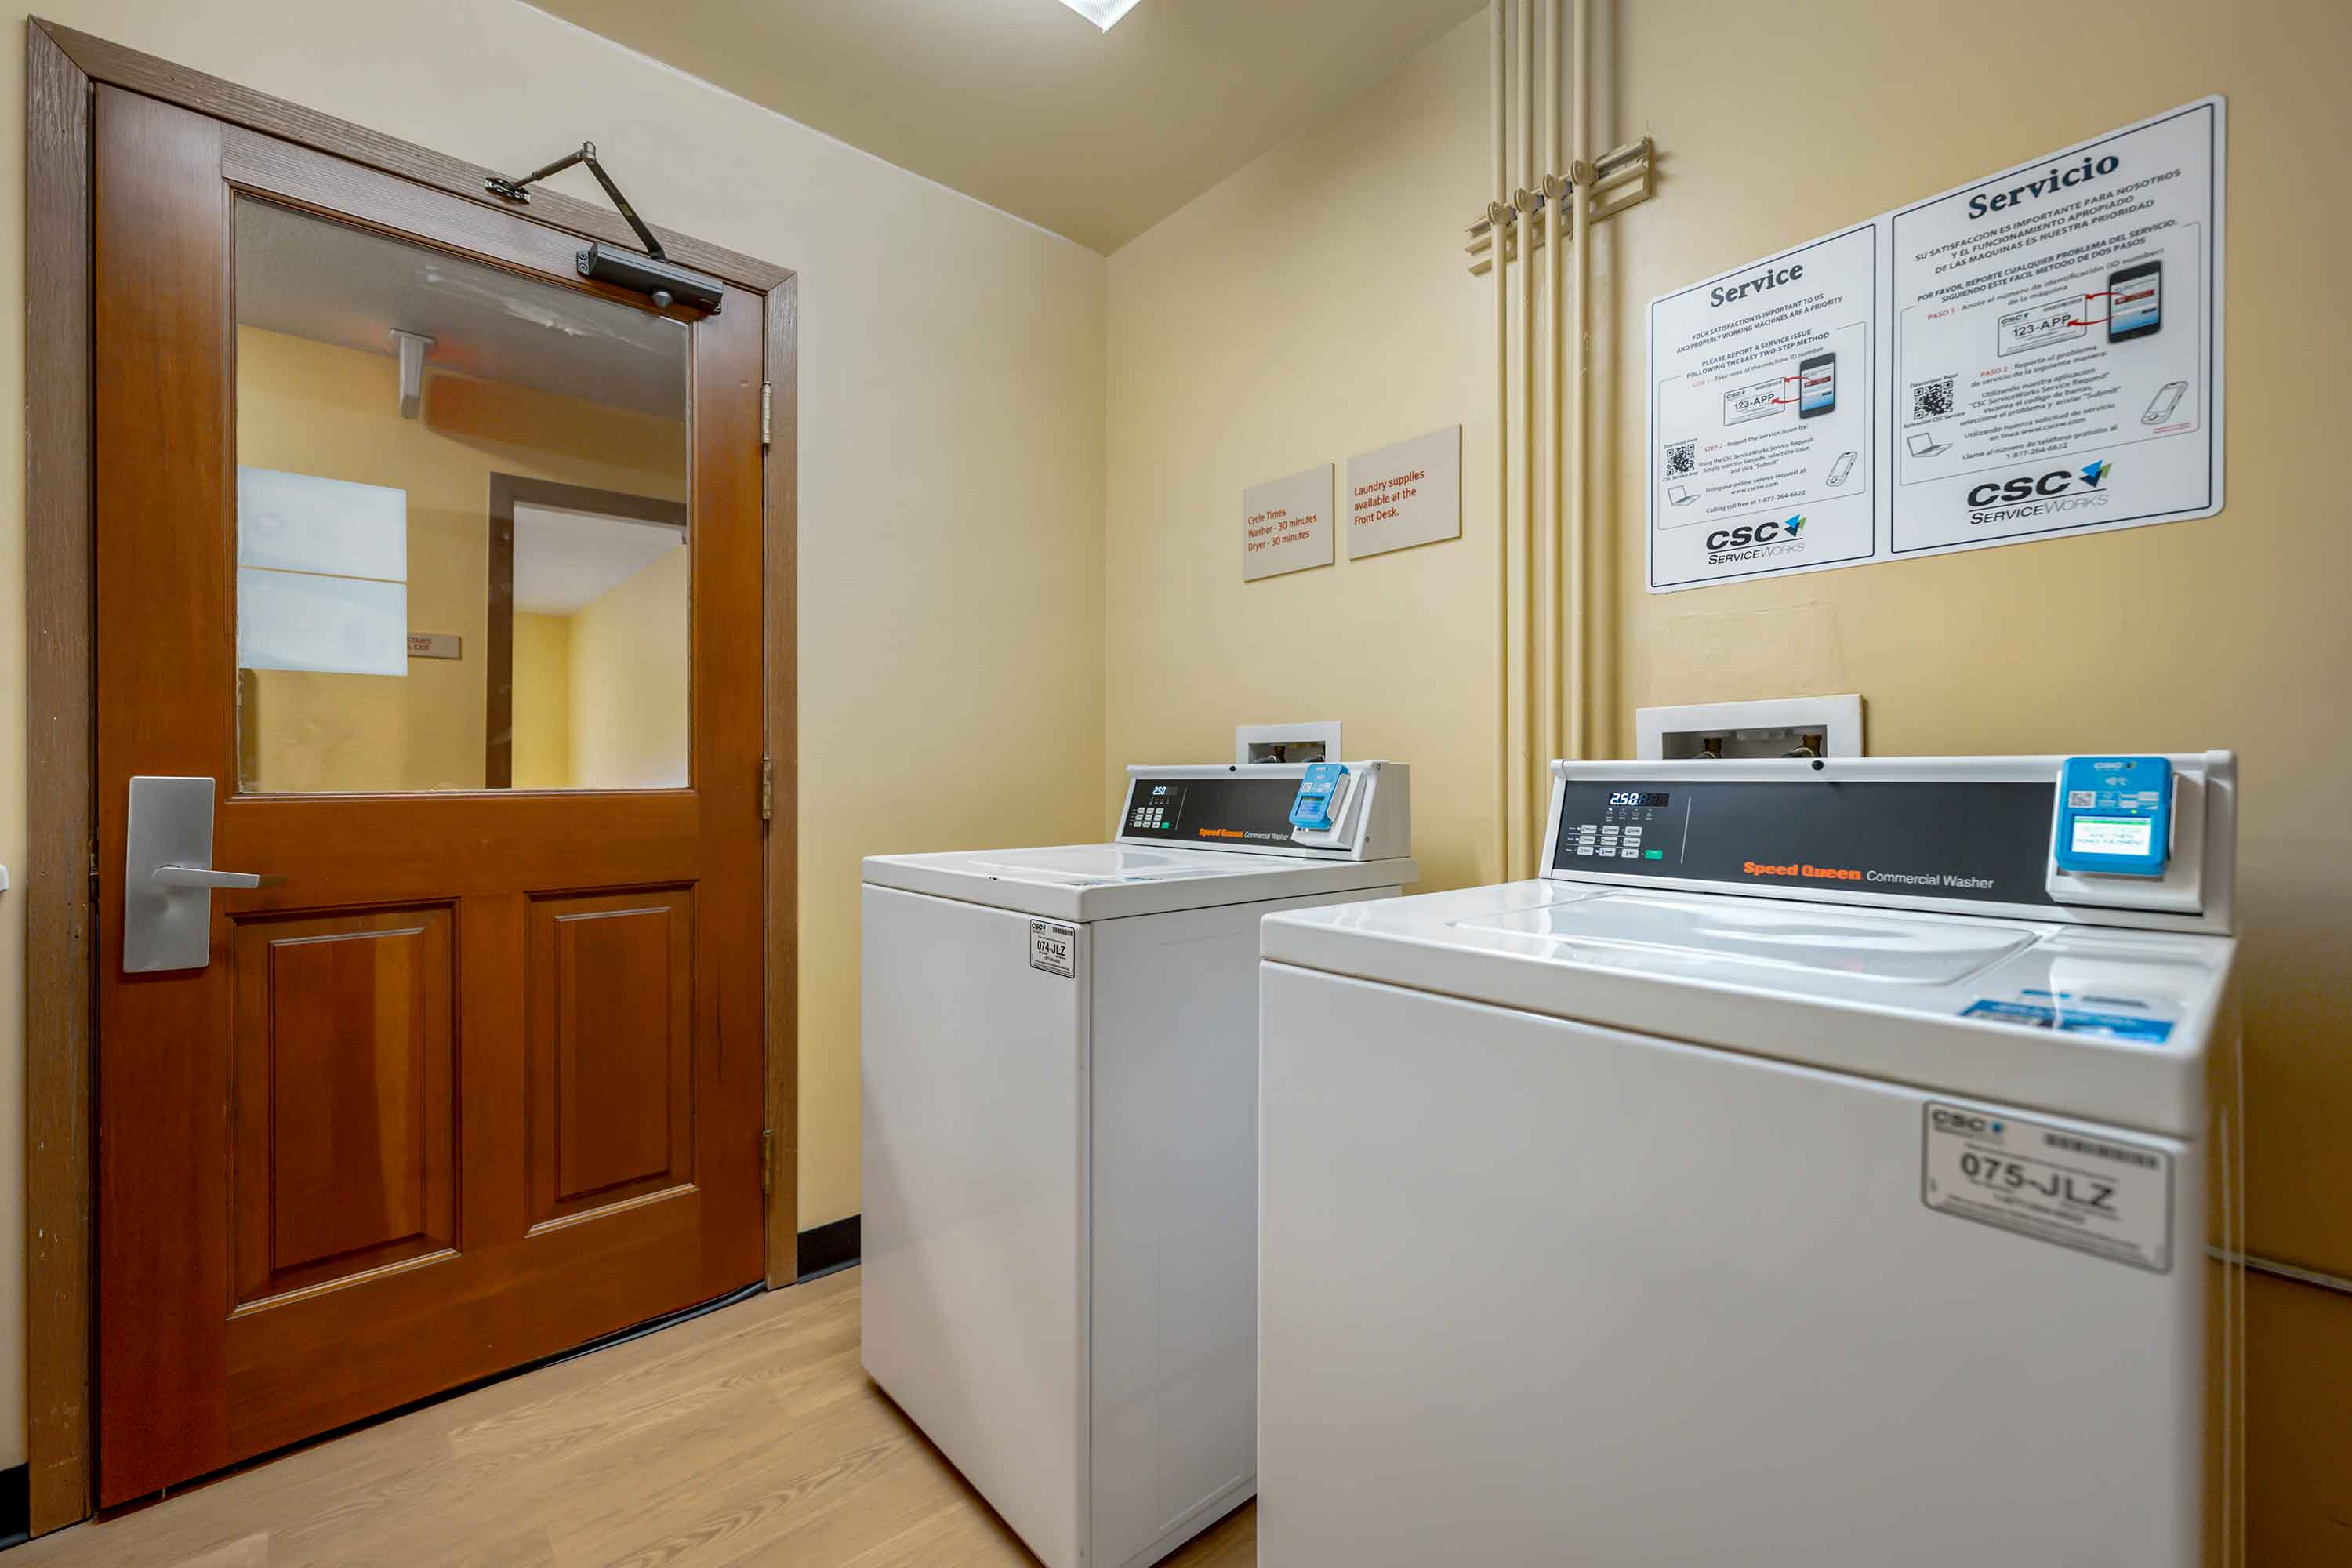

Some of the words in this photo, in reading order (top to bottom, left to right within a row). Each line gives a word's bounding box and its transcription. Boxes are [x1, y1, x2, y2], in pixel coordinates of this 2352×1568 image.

[1969, 156, 2118, 218] Servicio
[1915, 252, 1926, 261] SU
[1929, 229, 1997, 256] SATISFACCION
[2000, 224, 2011, 234] ES
[2013, 201, 2081, 228] IMPORTANTE
[2084, 191, 2113, 206] PARA
[2116, 169, 2180, 194] NOSOTROS
[1960, 248, 1969, 256] EL
[1973, 217, 2064, 251] FUNCIONAMIENTO
[2068, 195, 2133, 221] APROPIADO
[1935, 263, 1948, 274] DE
[1949, 258, 1966, 269] LAS
[1969, 241, 2023, 263] MAQUINAS
[2025, 236, 2037, 245] ES
[2039, 220, 2088, 240] NUESTRA
[2091, 199, 2154, 223] PRIORIDAD
[1918, 292, 1933, 301] POR
[1965, 270, 2002, 286] REPORTE
[2004, 255, 2053, 275] CUALQUIER
[2056, 240, 2105, 260] PROBLEMA
[2108, 234, 2125, 244] DEL
[1941, 285, 1985, 302] SIGUIENDO
[1987, 278, 2007, 289] ESTE
[2009, 270, 2033, 282] FACIL
[2035, 258, 2074, 274] METODO
[2077, 253, 2089, 263] DE
[2092, 246, 2111, 259] DOS
[2114, 237, 2145, 251] PASOS
[1711, 265, 1802, 307] Service
[1692, 330, 1708, 339] YOUR
[1710, 315, 1754, 335] SATISFACTION
[1762, 299, 1802, 318] IMPORTANT
[1927, 309, 1948, 320] PASO
[1962, 299, 1985, 310] Anote
[2001, 314, 2021, 324] CSC
[1676, 344, 1689, 353] AND
[1690, 334, 1720, 349] PROPERLY
[1722, 325, 1752, 339] WORKING
[1754, 313, 1788, 328] MACHINES
[1790, 308, 1802, 318] ARE
[1811, 296, 1842, 310] PRIORITY
[2013, 314, 2071, 336] 123-APP
[1686, 362, 1726, 378] FOLLOWING
[1740, 353, 1757, 363] EASY
[1759, 342, 1795, 357] TWO-STEP
[1797, 332, 1829, 346] METHOD
[1702, 354, 1725, 366] PLEASE
[1726, 346, 1753, 358] REPORT
[1761, 336, 1789, 349] SERVICE
[1791, 328, 1811, 339] ISSUE
[1981, 368, 2001, 377] PASO
[2014, 358, 2045, 368] Reporte
[2056, 345, 2096, 359] problema
[1982, 374, 2011, 385] servicio
[2034, 359, 2071, 372] siguiente
[1726, 390, 1740, 399] CSC
[1734, 393, 1774, 409] 123-APP
[1355, 481, 1386, 496] Laundry
[1388, 470, 1424, 487] supplies
[1967, 471, 2072, 506] CSC
[1355, 494, 1389, 511] available
[1392, 492, 1399, 502] at
[1403, 488, 1416, 499] the
[1248, 514, 1265, 526] Cycle
[1267, 509, 1286, 520] Times
[1248, 526, 1272, 538] Washer
[1279, 521, 1287, 531] 30
[1290, 514, 1317, 528] minutes
[1355, 514, 1374, 525] Front
[1376, 508, 1399, 520] Desk.
[1248, 541, 1266, 552] Dryer
[1272, 536, 1280, 546] 30
[1282, 531, 1310, 543] minutes
[1706, 521, 1778, 550] CSC
[1743, 861, 1798, 877] Speed
[1802, 864, 1861, 880] Queen
[1866, 869, 1940, 886] Commercial
[1942, 875, 1994, 890] Washer
[1037, 940, 1066, 956] 074-JLZ
[1961, 1152, 2116, 1212] 075-JLZ
